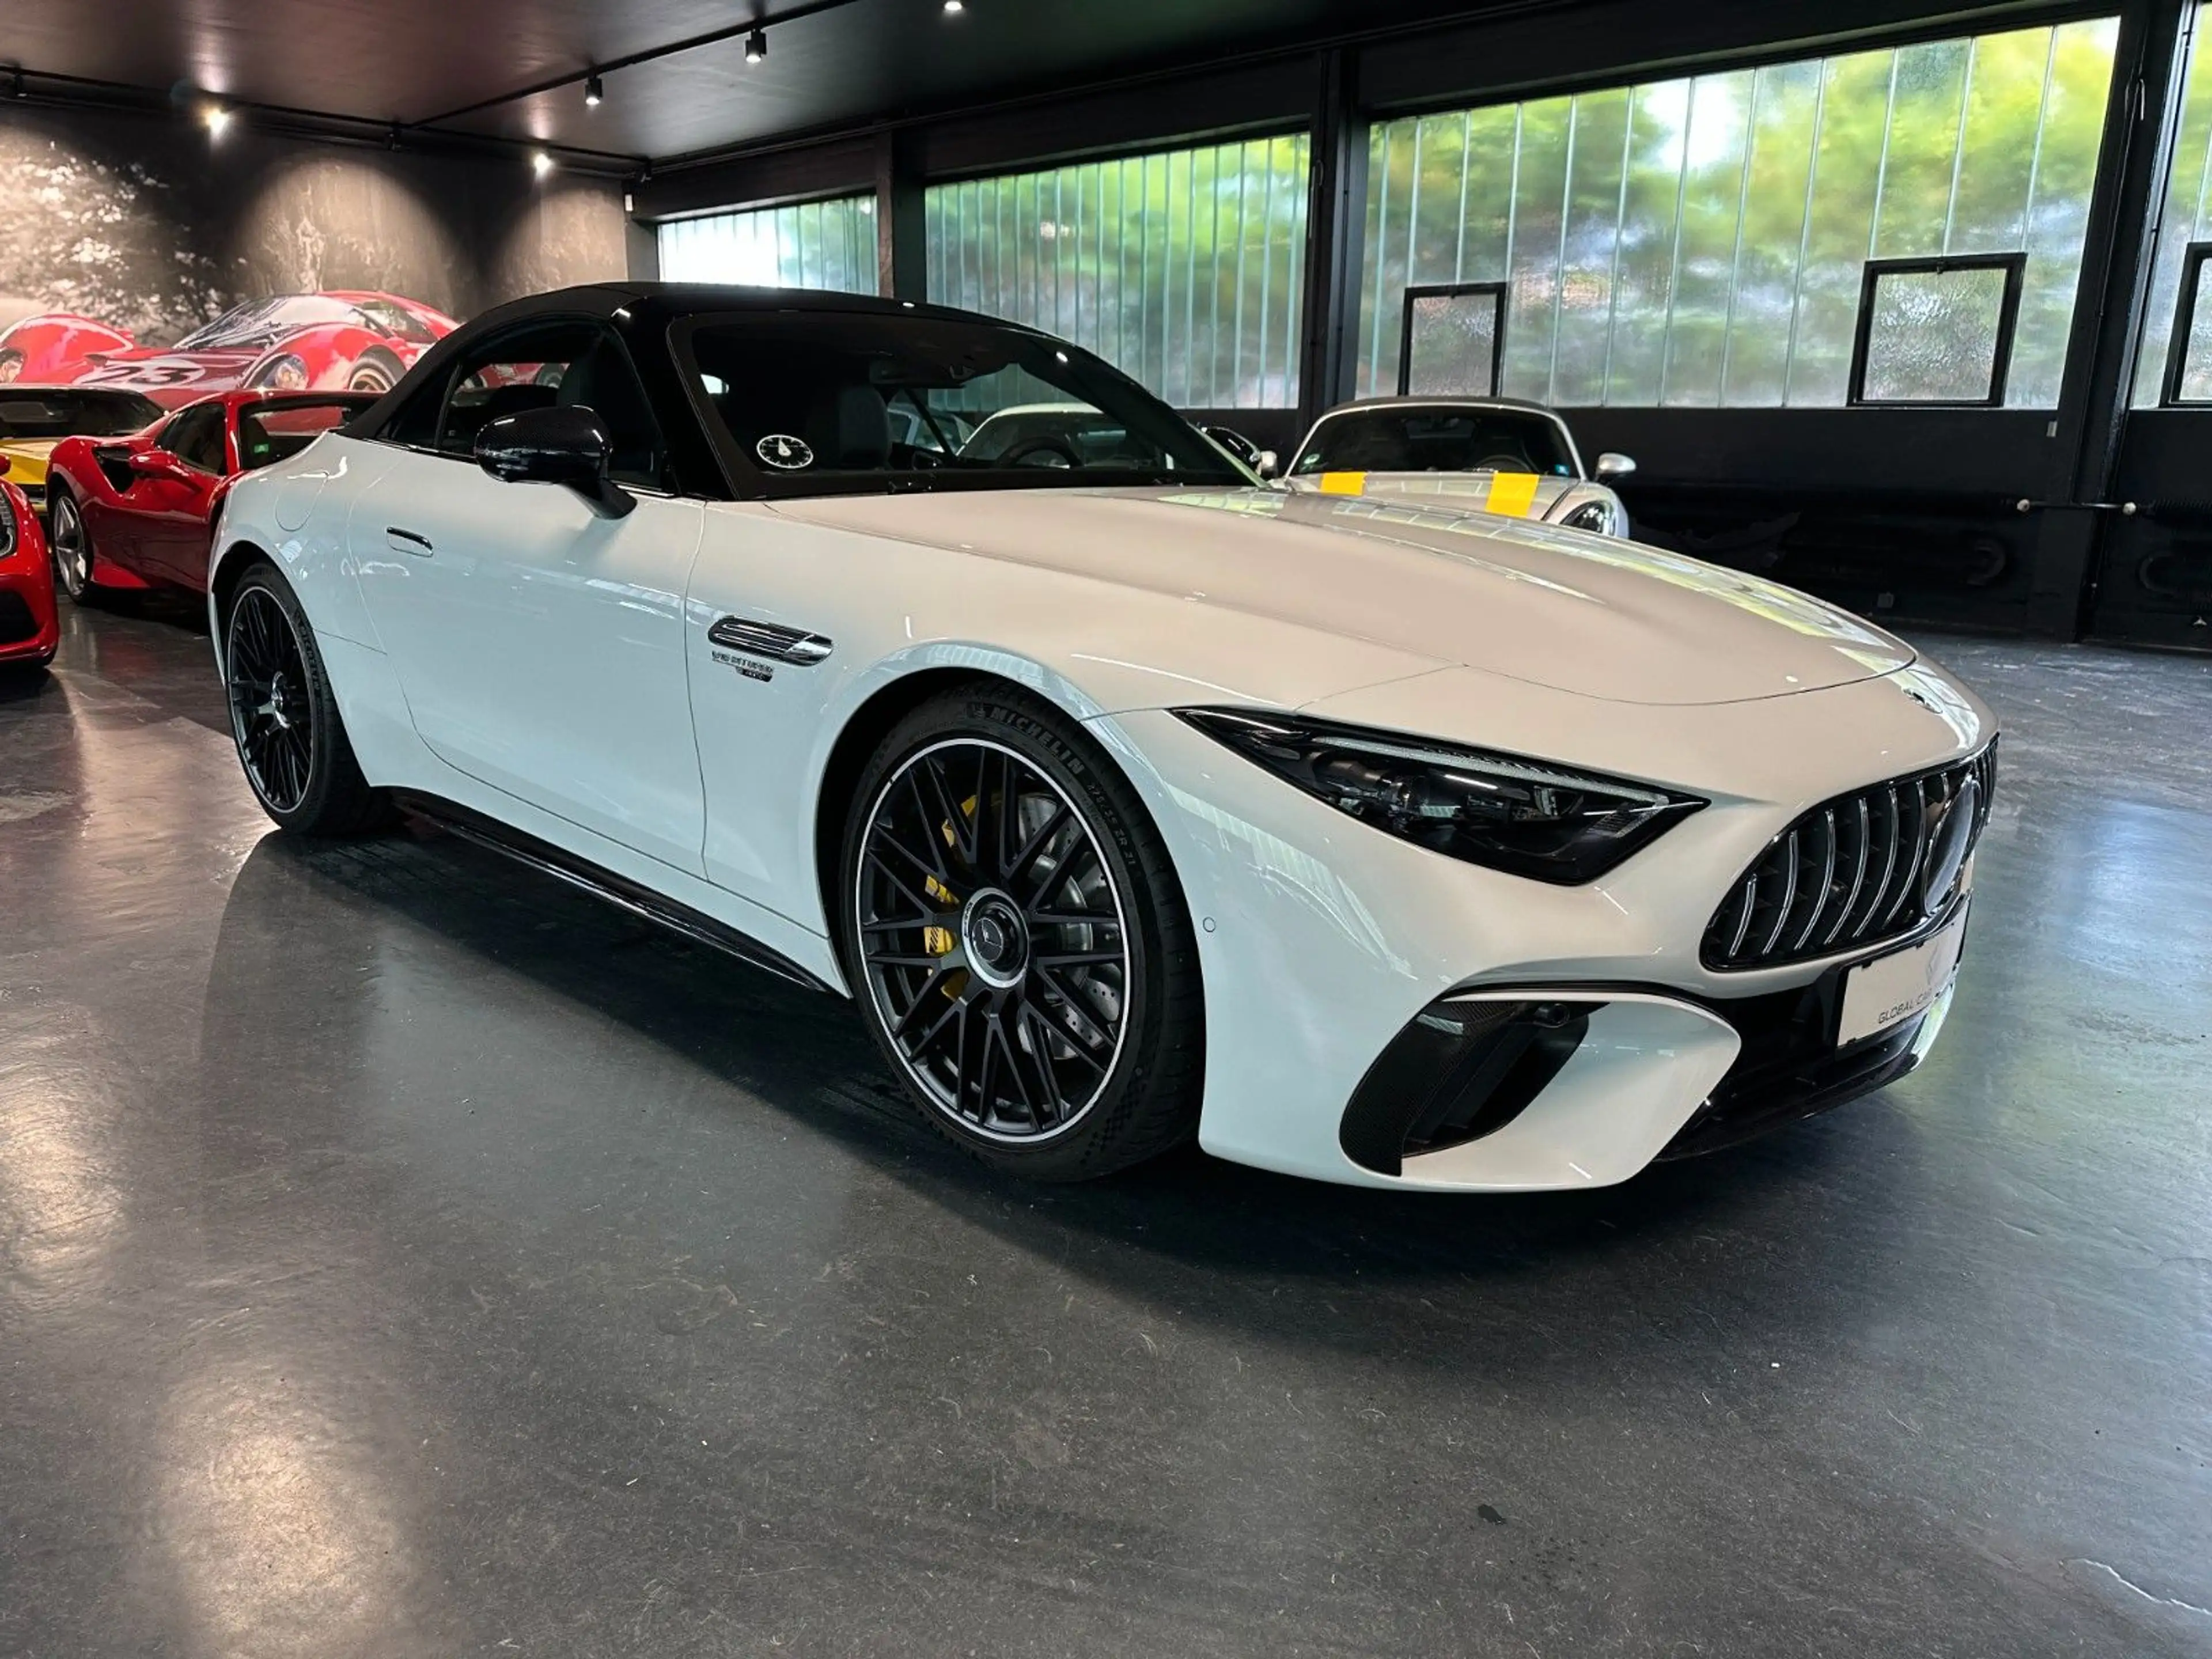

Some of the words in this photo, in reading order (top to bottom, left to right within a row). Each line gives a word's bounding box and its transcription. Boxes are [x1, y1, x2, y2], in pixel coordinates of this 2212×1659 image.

[82, 366, 203, 384] 23
[990, 706, 1085, 775] MICHELIN
[1877, 1001, 1914, 1024] GLOBAL
